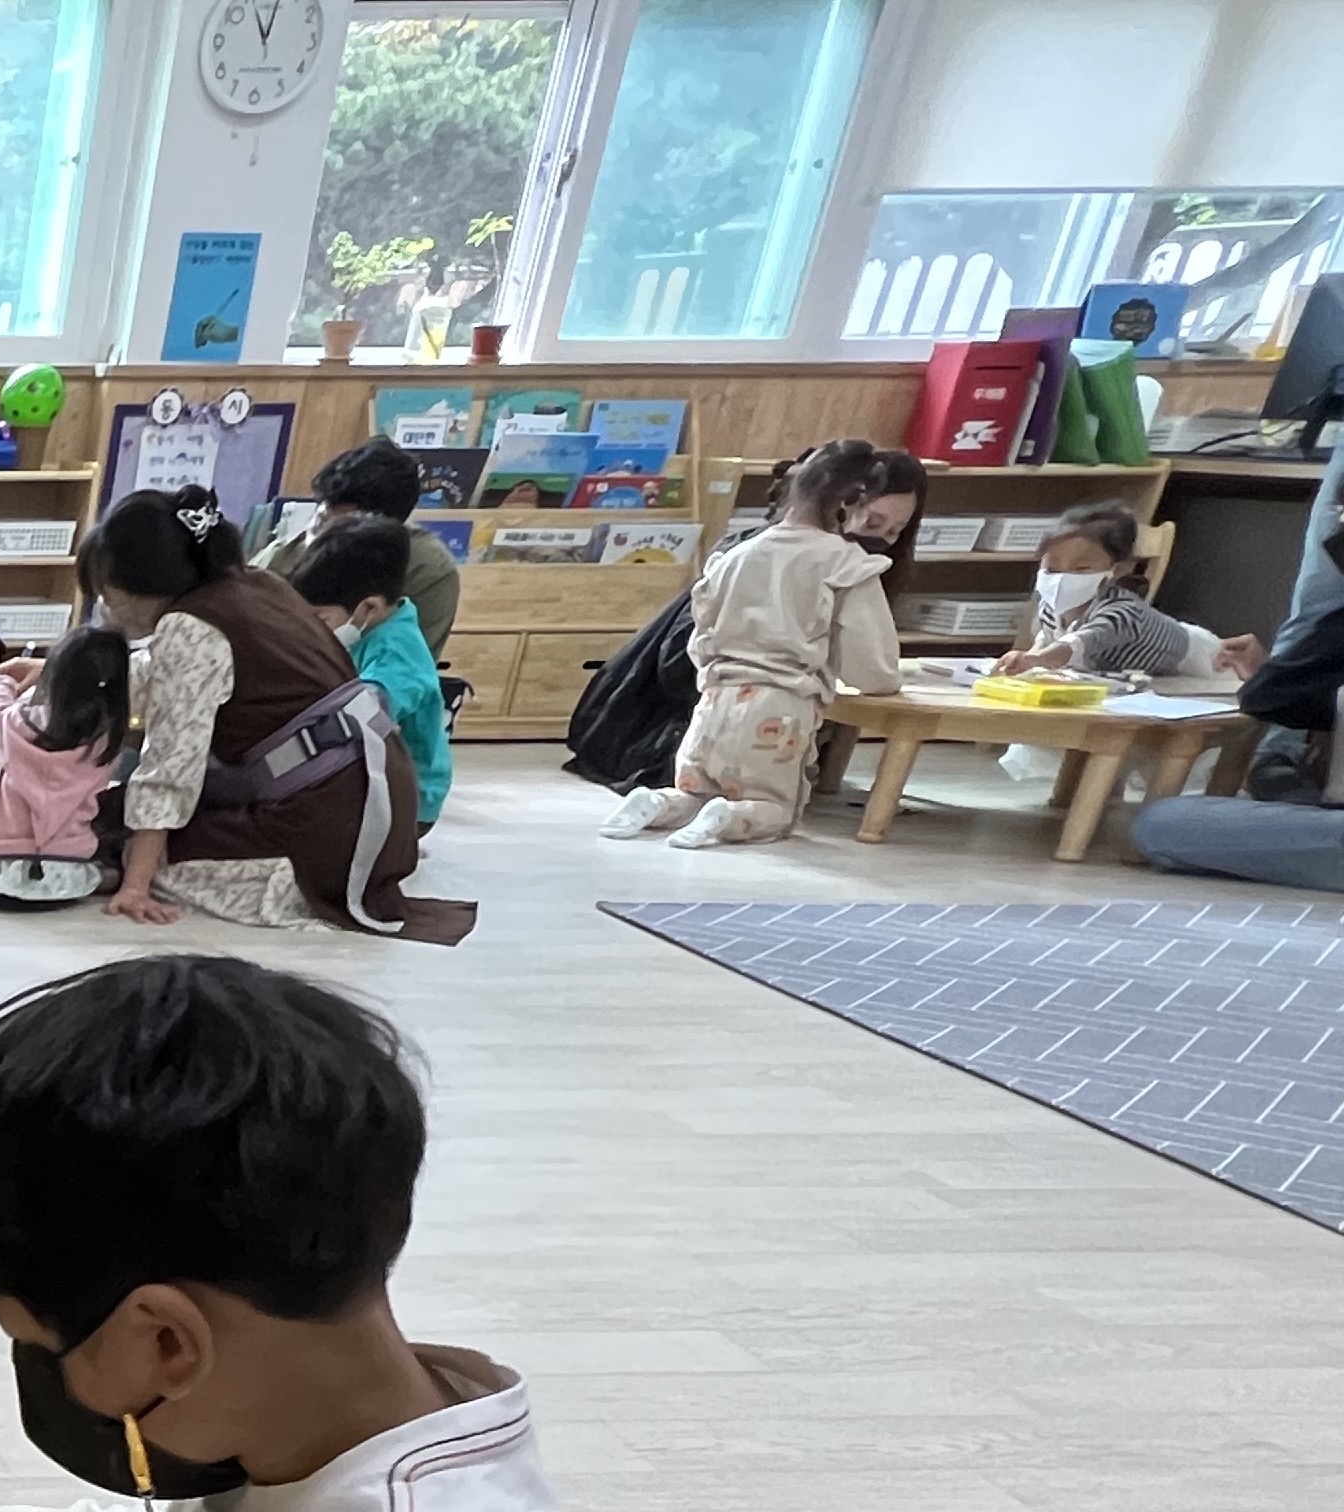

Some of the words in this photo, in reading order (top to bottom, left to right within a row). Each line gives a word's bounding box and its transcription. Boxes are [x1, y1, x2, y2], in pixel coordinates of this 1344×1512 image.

[305, 4, 316, 24] 2
[213, 32, 225, 51] 9
[306, 31, 318, 52] 3
[296, 59, 305, 74] 4
[230, 78, 240, 98] 7
[248, 87, 261, 106] 6
[274, 78, 285, 98] 5
[159, 398, 175, 419] 동
[228, 398, 244, 417] 시
